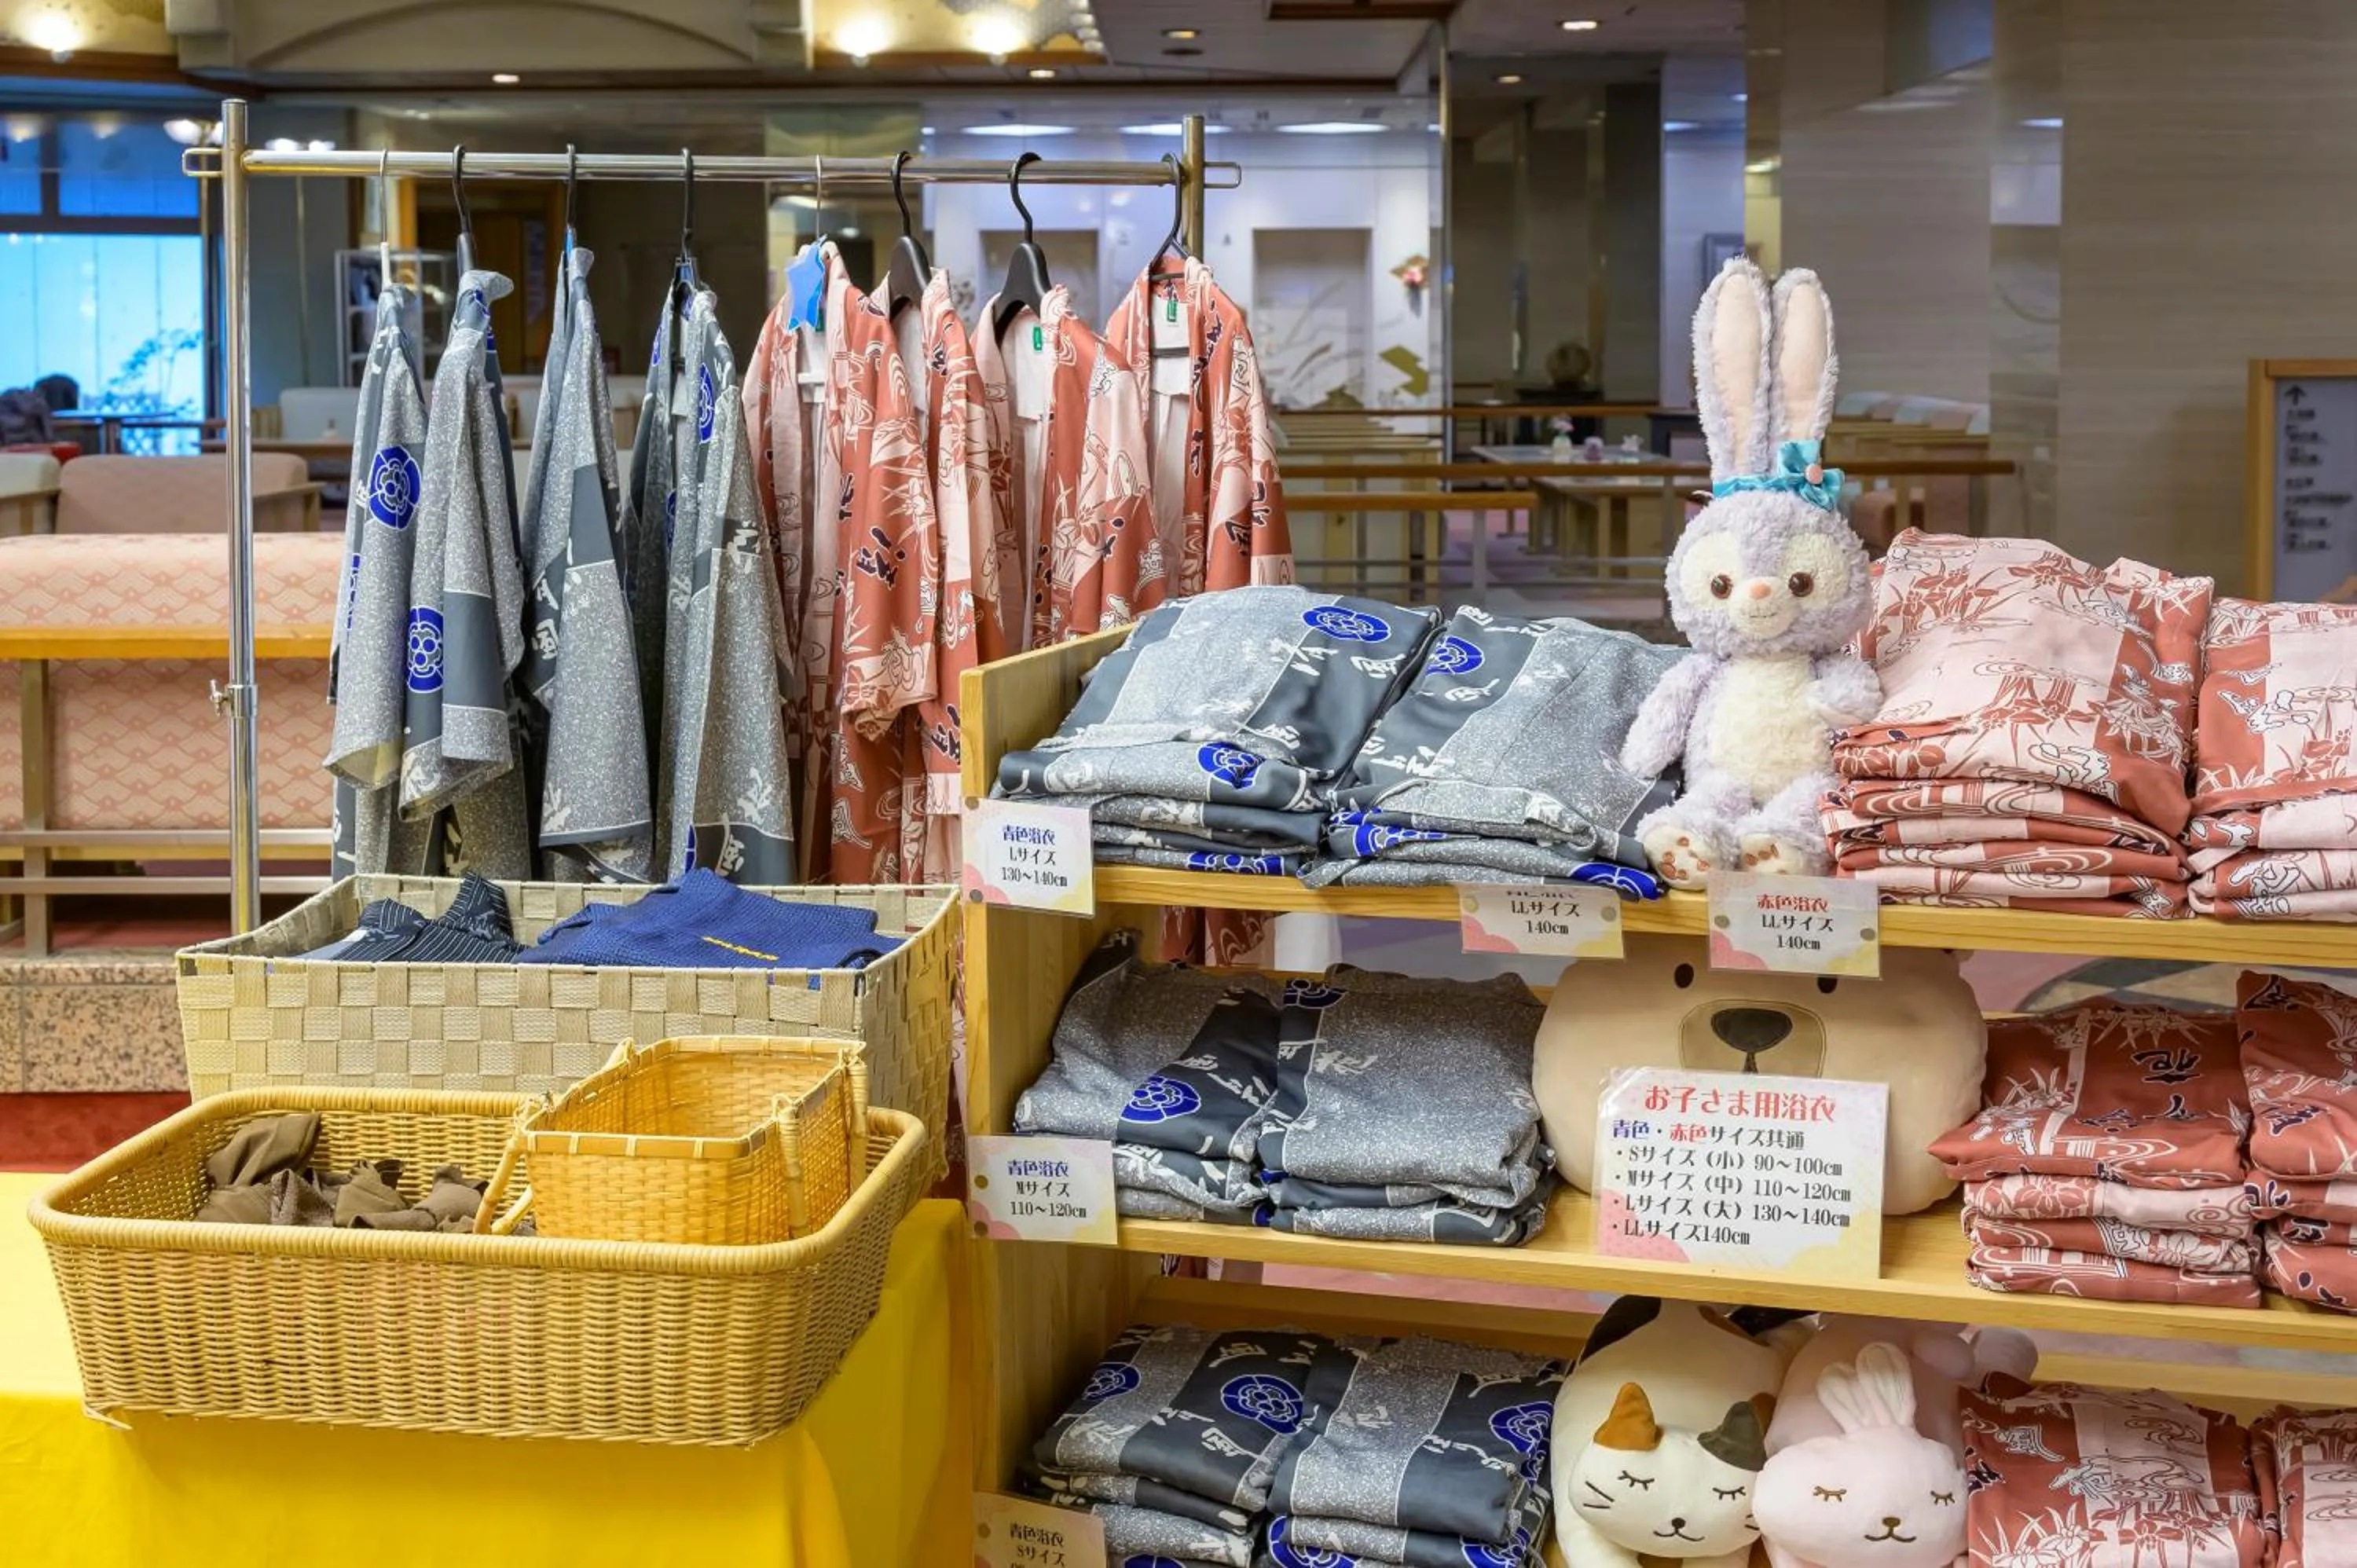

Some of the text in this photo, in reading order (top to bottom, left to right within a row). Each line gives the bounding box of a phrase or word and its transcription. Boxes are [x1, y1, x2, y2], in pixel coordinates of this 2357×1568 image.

[1010, 847, 1056, 865] Lサイズ
[1511, 900, 1582, 917] LLサイズ
[1757, 894, 1828, 913] 赤色浴衣
[1525, 920, 1569, 935] 140cm
[1762, 914, 1833, 932] LLサイズ
[1777, 935, 1820, 950] 140cm
[1644, 1085, 1836, 1123] お子さま用浴衣
[1613, 1119, 1805, 1149] 青色・赤色サイズ共通
[1008, 1160, 1069, 1177] 青色浴衣
[1016, 1181, 1069, 1197] Mサイズ
[1017, 1545, 1066, 1567] Sサイズ
